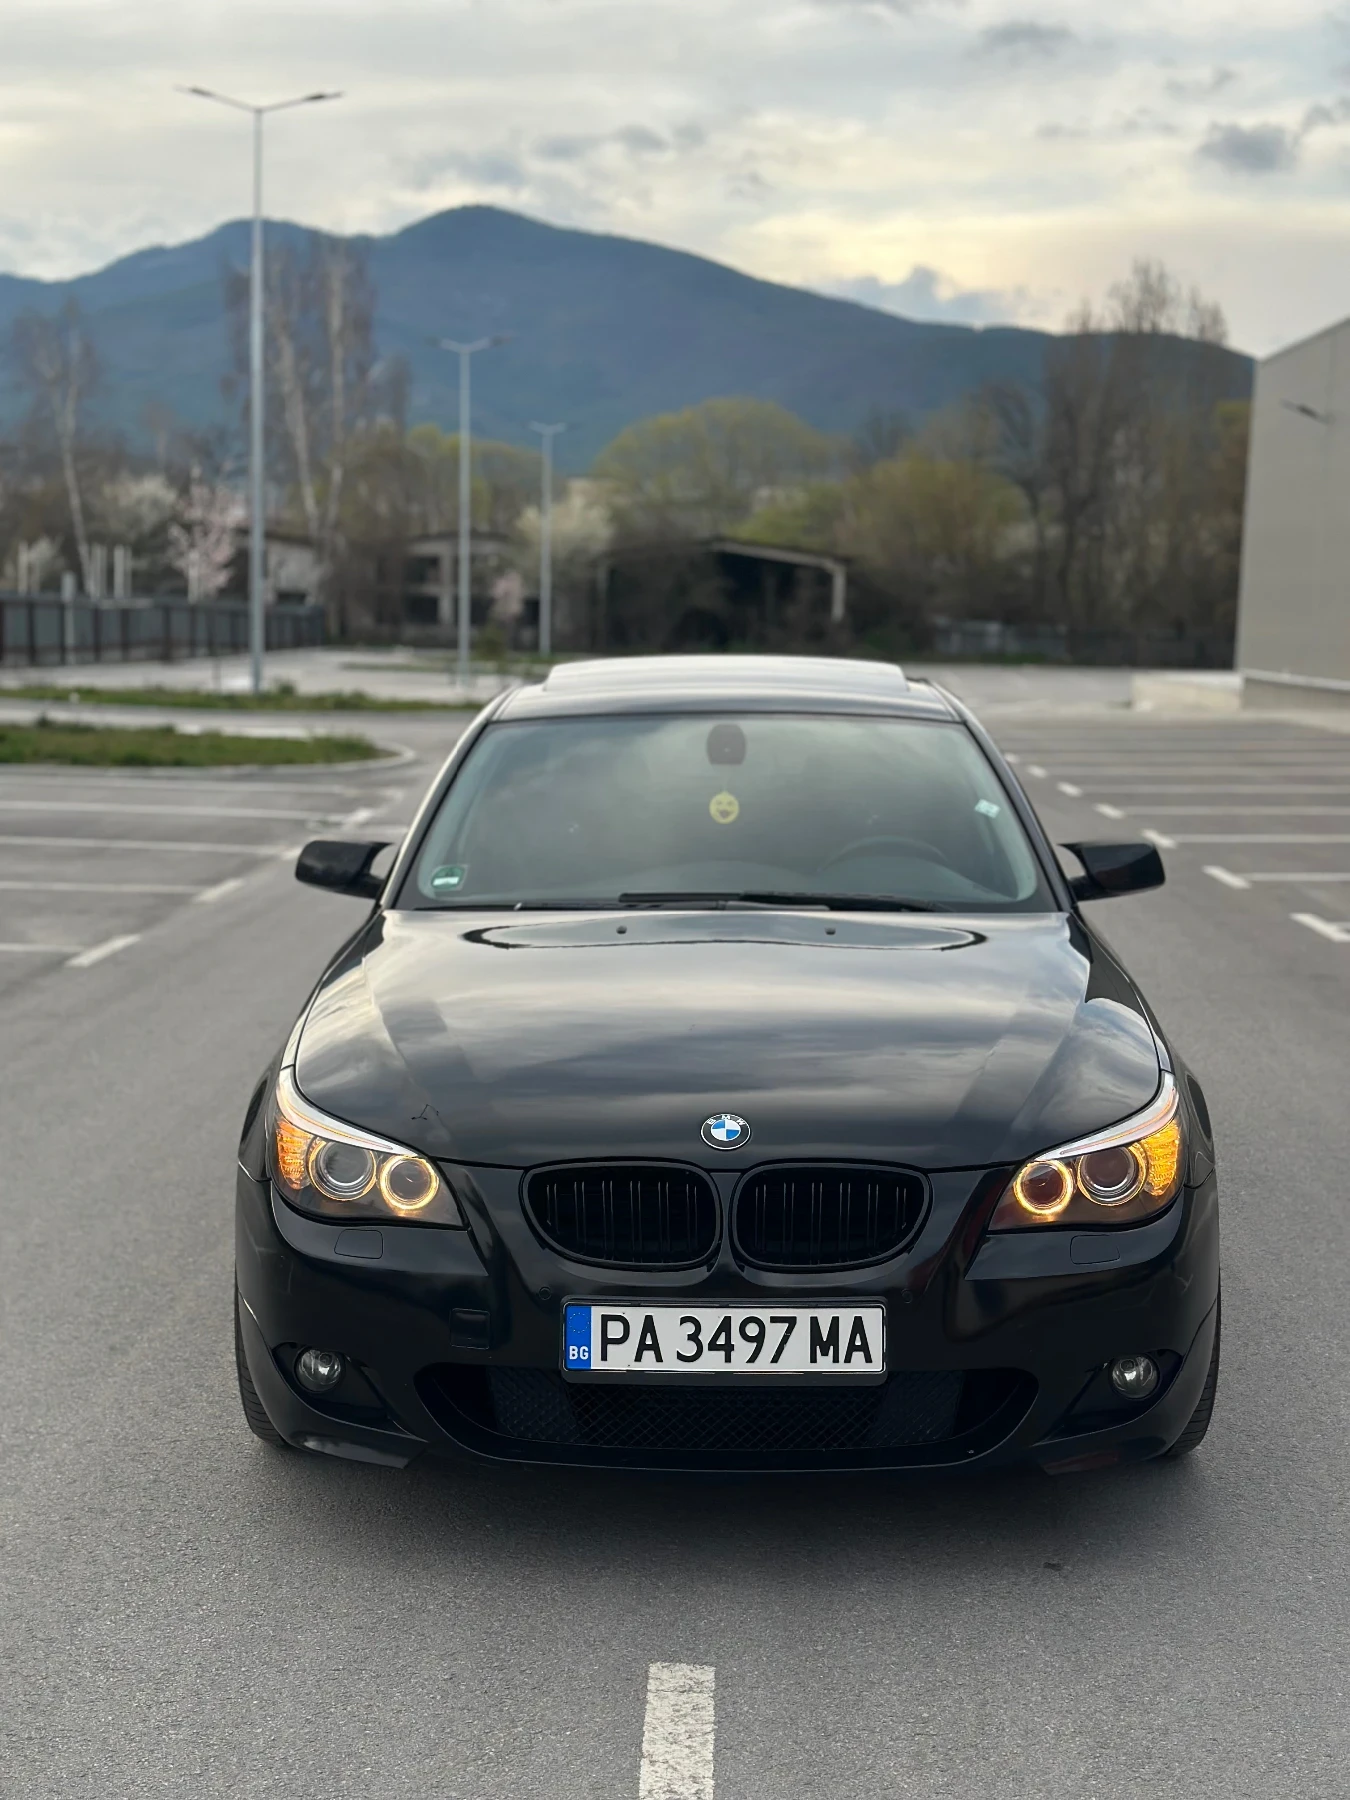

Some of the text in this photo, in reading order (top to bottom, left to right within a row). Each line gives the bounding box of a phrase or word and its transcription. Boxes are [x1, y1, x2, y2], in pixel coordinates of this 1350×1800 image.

[569, 1345, 589, 1360] BG
[600, 1314, 873, 1364] PA 3497 MA
